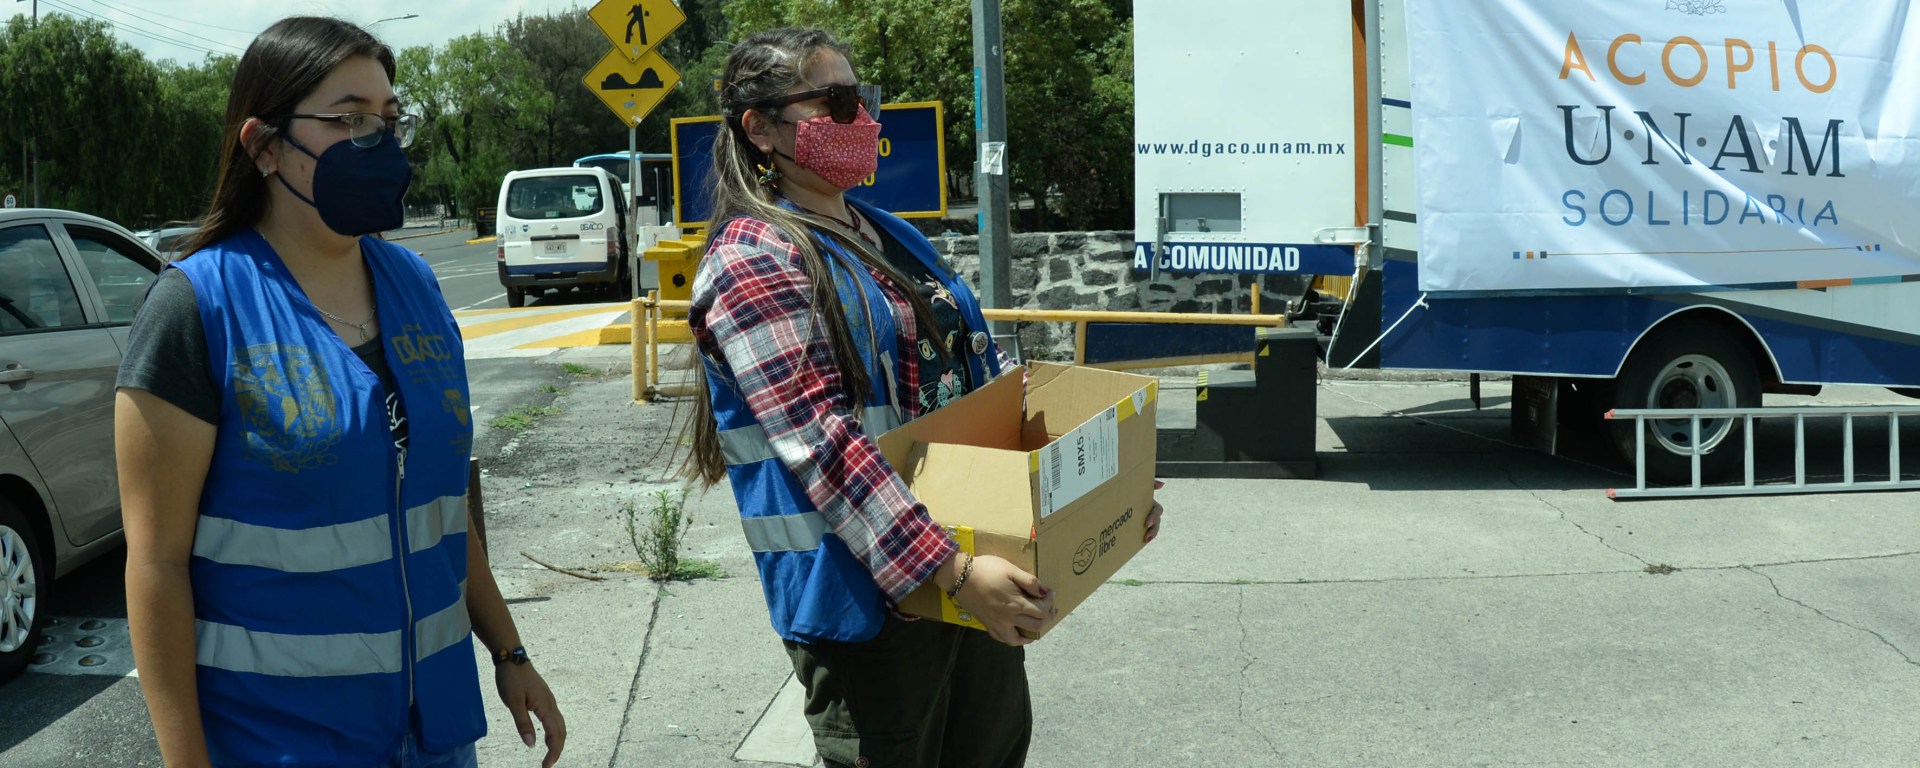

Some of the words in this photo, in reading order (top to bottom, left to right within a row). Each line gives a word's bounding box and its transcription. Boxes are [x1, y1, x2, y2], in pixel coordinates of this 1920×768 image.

[1558, 30, 1837, 94] ACOPIO
[1137, 139, 1345, 157] www.dgaco.unam.mx
[1562, 189, 1838, 226] SOLIDARIA
[1158, 245, 1300, 271] COMUNIDAD
[1076, 435, 1086, 476] SMX5
[1099, 507, 1133, 541] mercado
[1098, 535, 1117, 558] libre
